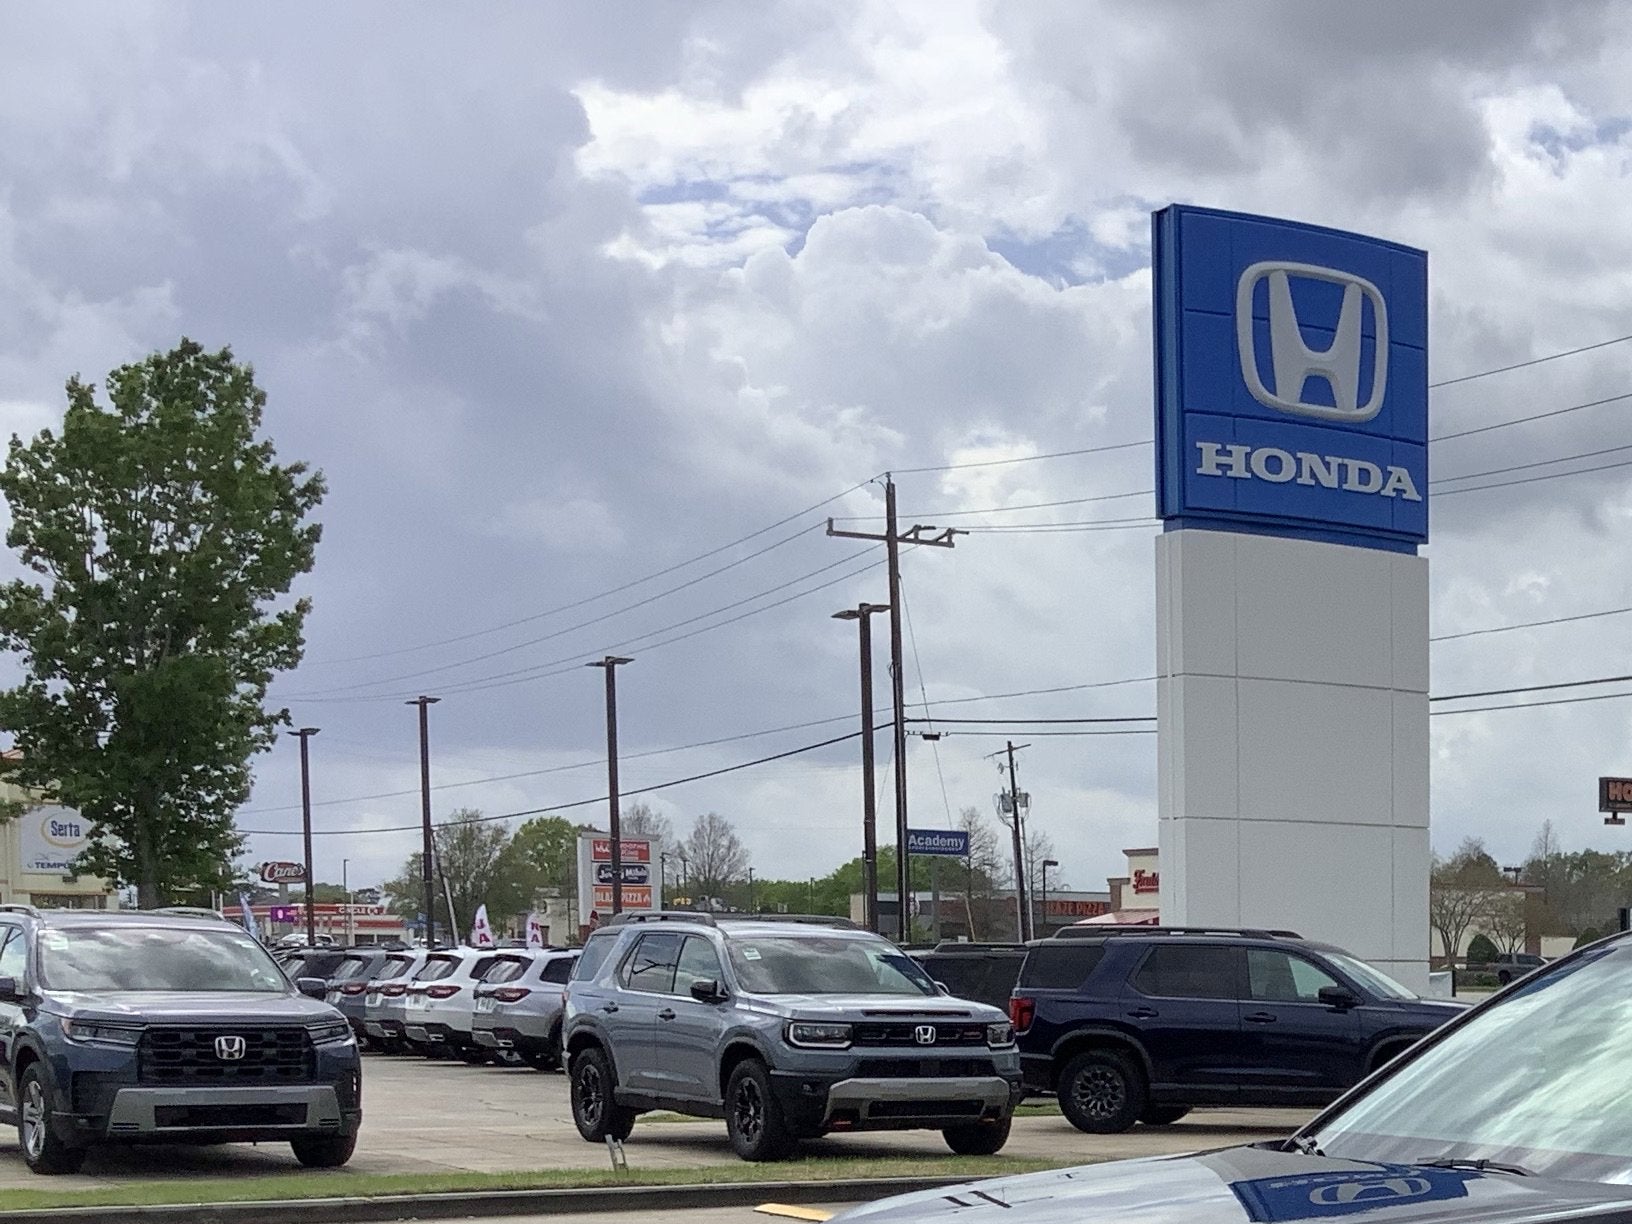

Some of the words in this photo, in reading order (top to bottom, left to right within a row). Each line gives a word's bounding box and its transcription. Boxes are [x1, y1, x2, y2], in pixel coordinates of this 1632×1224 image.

[1196, 441, 1422, 502] HONDA
[50, 820, 80, 837] Serta
[908, 834, 965, 850] Academy
[264, 862, 305, 881] Cane's
[1075, 902, 1105, 915] PIZZA
